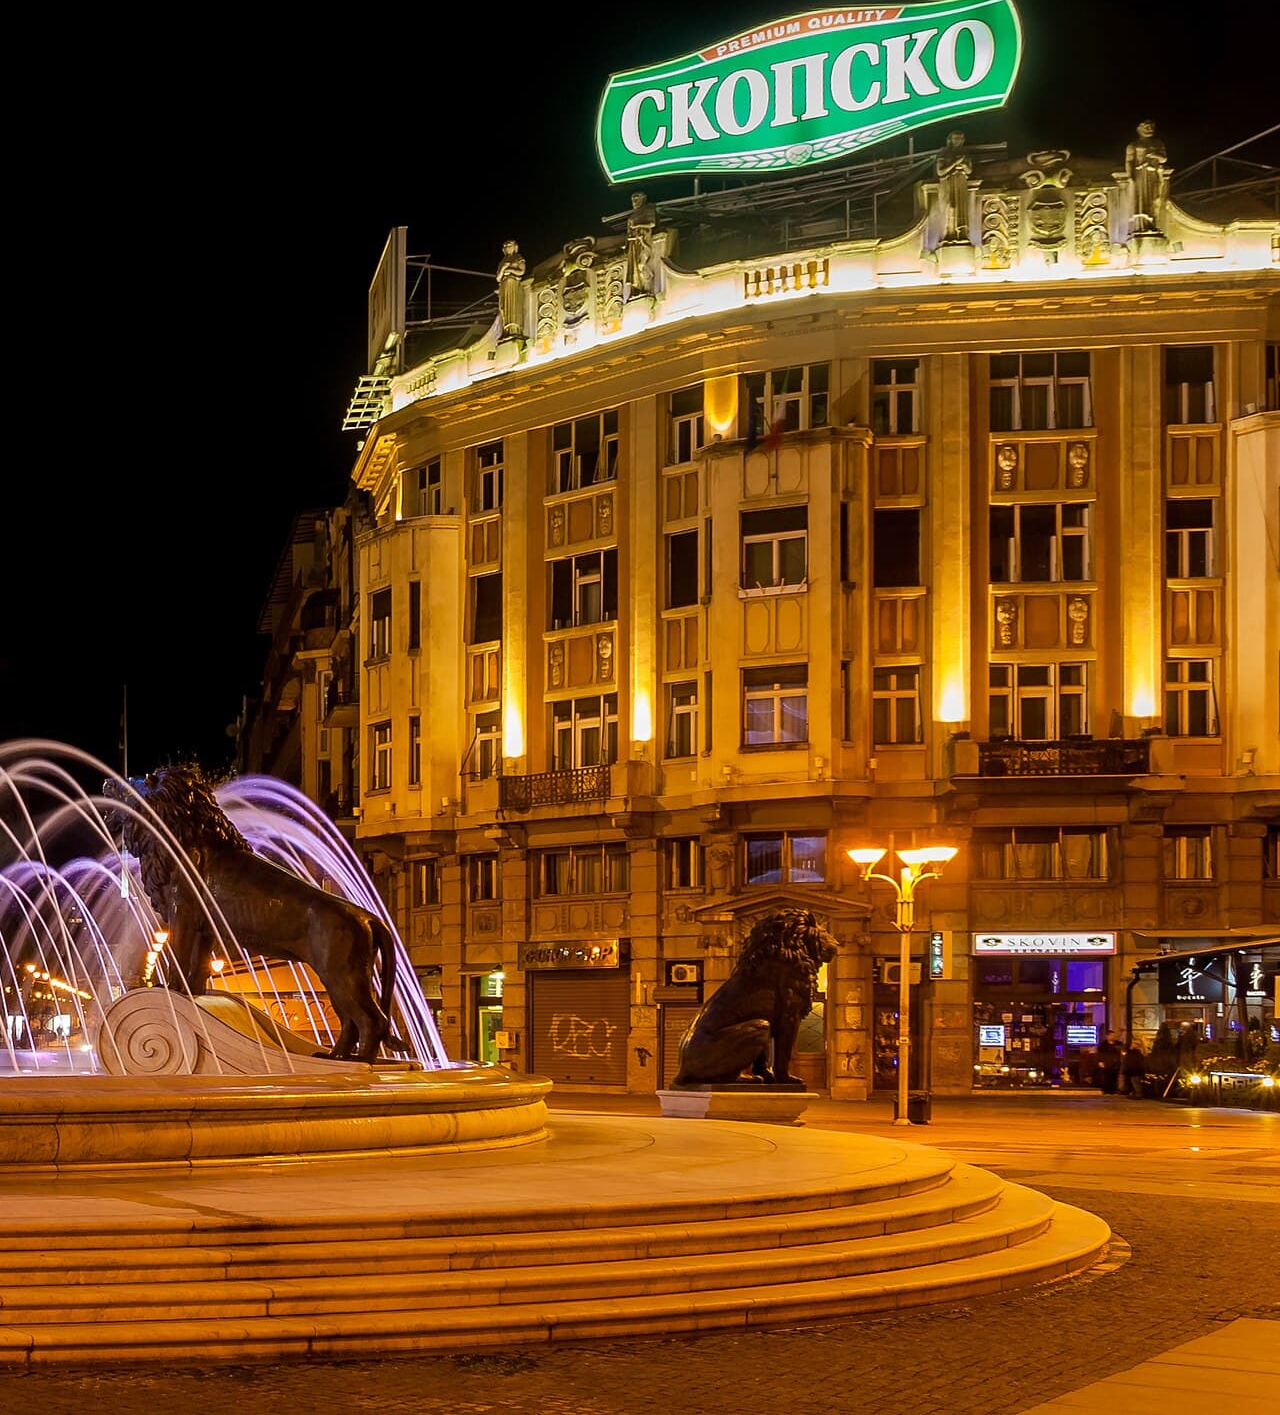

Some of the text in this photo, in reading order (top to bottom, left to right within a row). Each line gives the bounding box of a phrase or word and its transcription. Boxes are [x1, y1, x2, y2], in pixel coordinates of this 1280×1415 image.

[716, 9, 887, 57] PREMIUM QUALITY
[620, 19, 995, 155] СКОПСКО
[1007, 938, 1081, 947] SKOVIN
